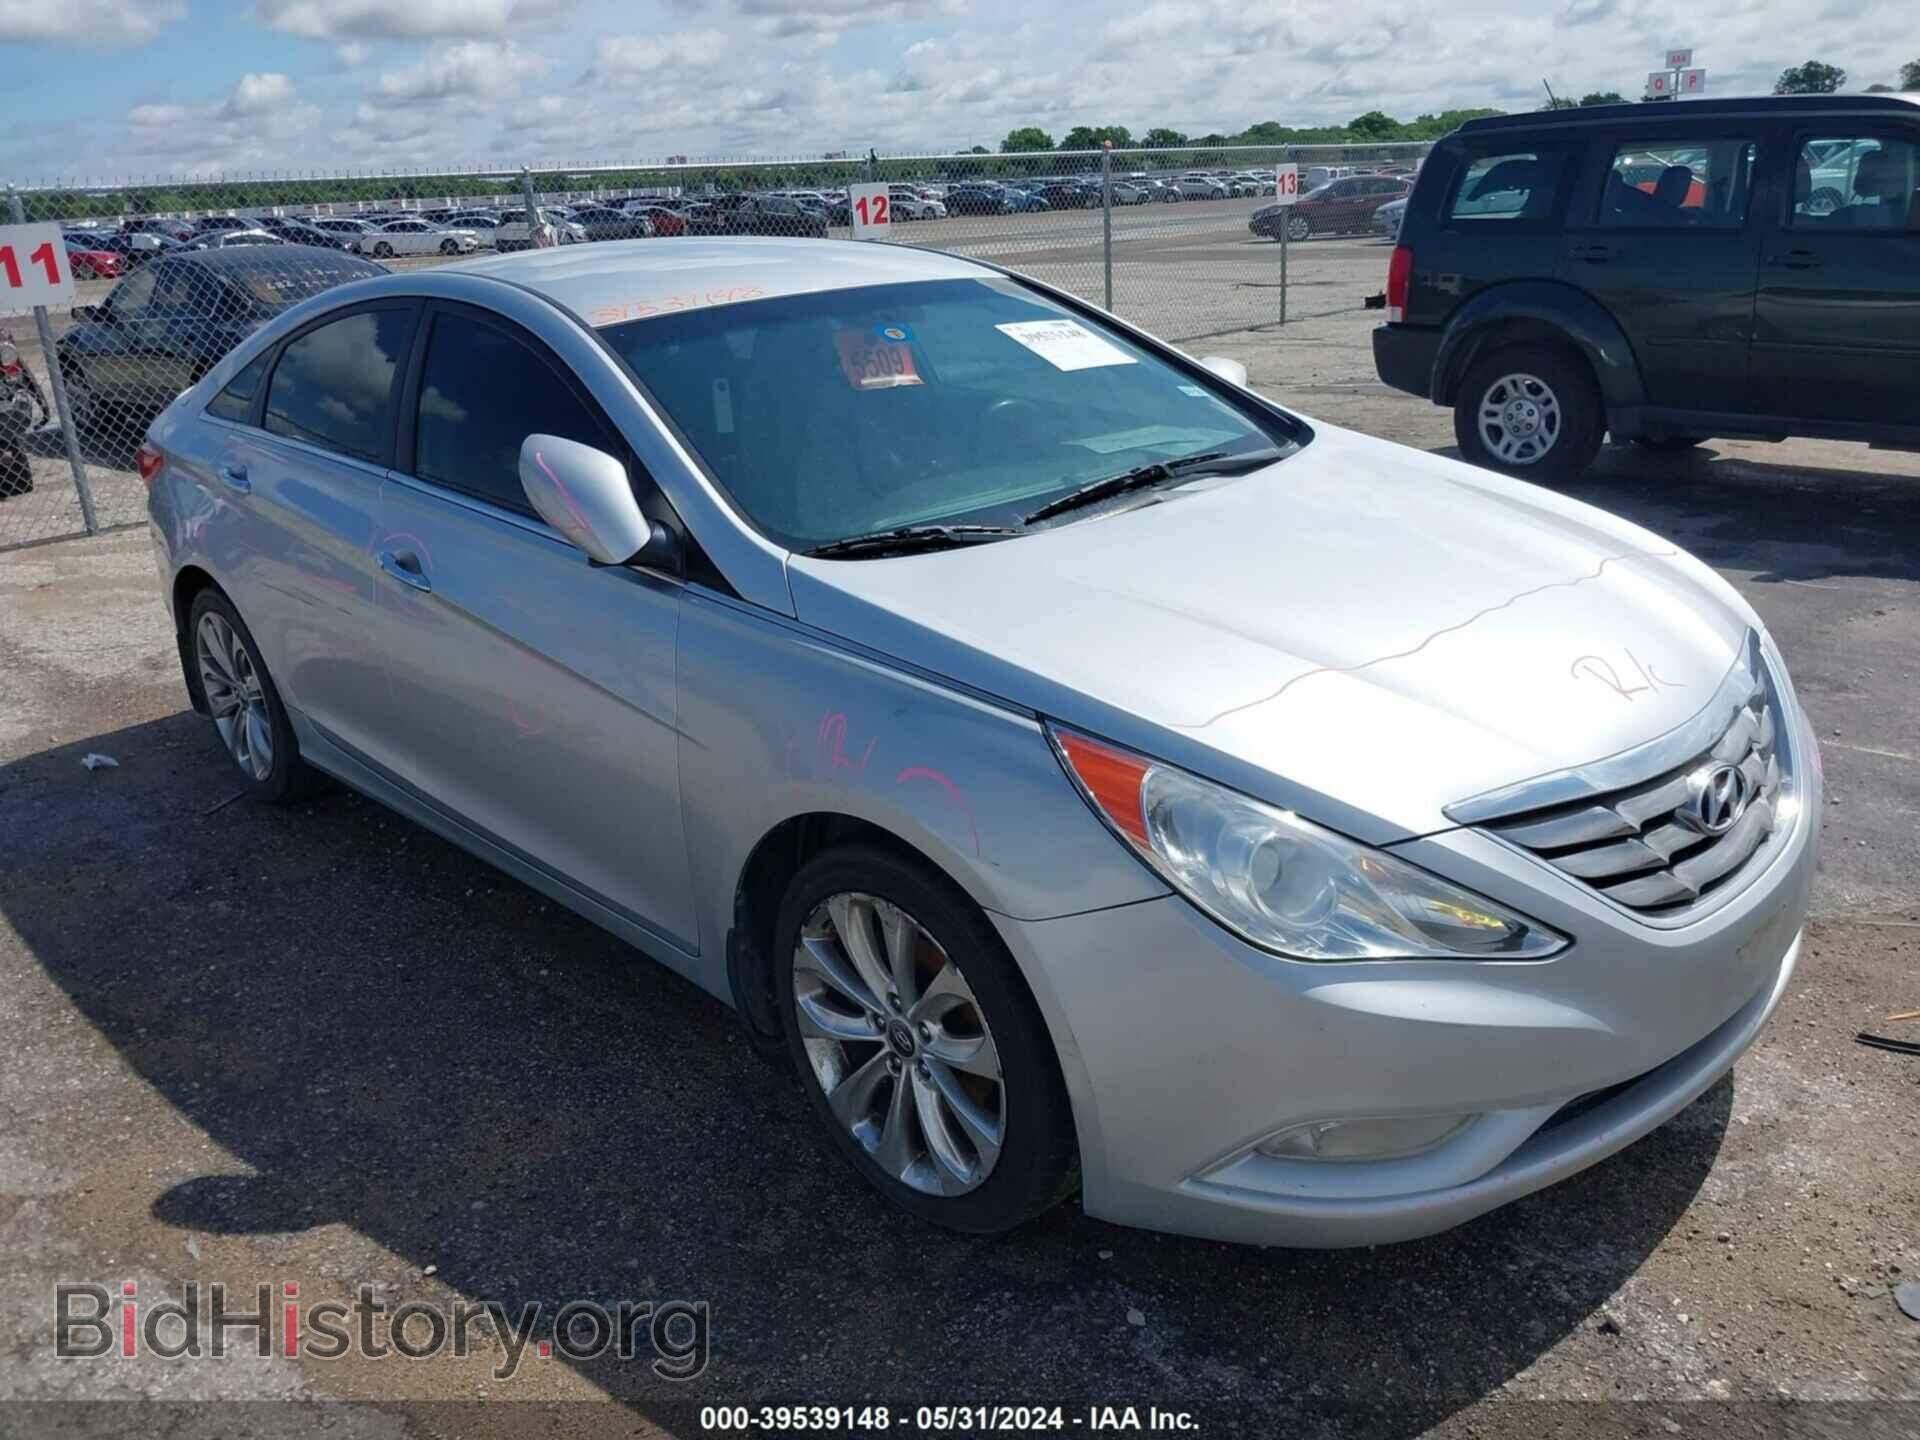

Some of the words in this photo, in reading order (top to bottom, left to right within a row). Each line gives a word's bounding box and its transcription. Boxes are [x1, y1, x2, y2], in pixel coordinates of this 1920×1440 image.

[1689, 75, 1697, 88] P
[1279, 173, 1296, 195] 13
[856, 196, 888, 226] 12
[0, 243, 61, 289] 11
